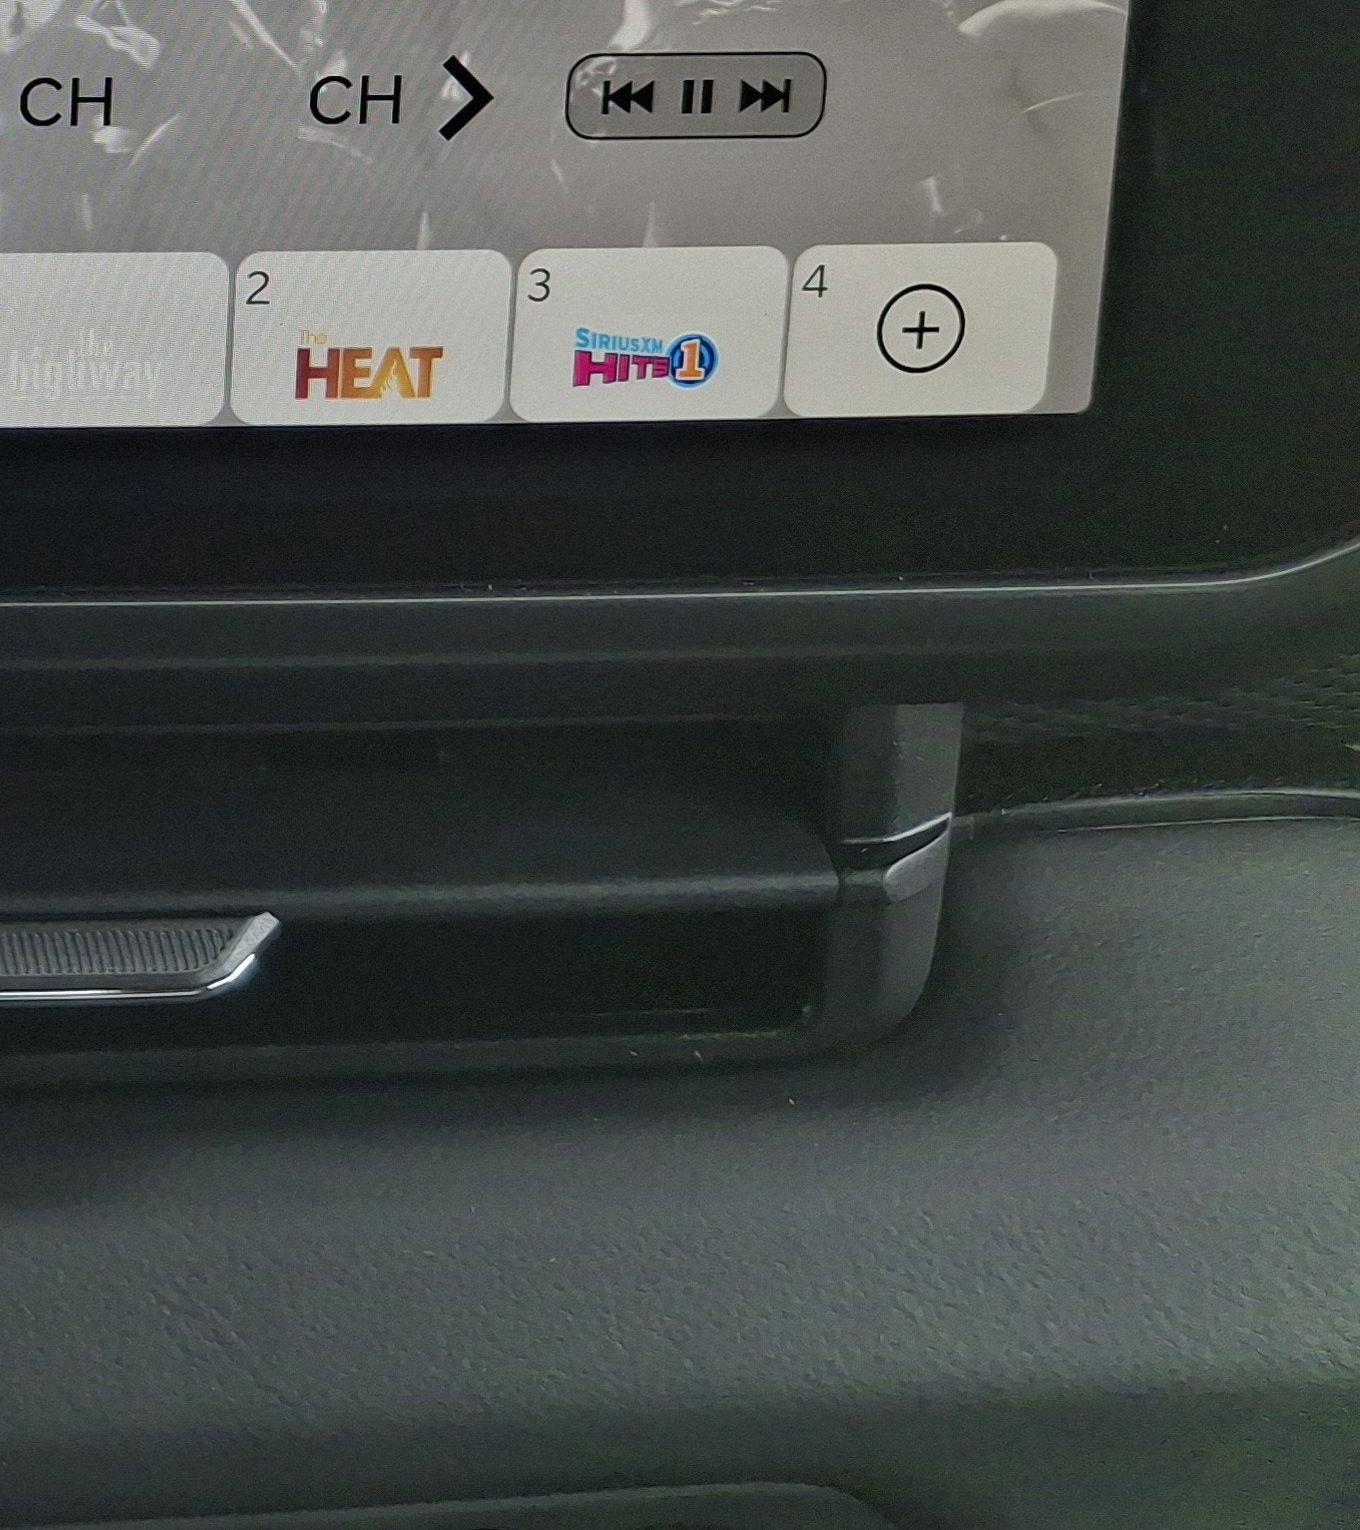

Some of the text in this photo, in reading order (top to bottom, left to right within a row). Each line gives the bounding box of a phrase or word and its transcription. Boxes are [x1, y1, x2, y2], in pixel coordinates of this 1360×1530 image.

[18, 75, 114, 128] CH
[308, 72, 404, 126] CH
[244, 269, 271, 307] 2
[526, 266, 552, 304] 3
[800, 263, 829, 300] 4
[293, 344, 444, 400] HEAT
